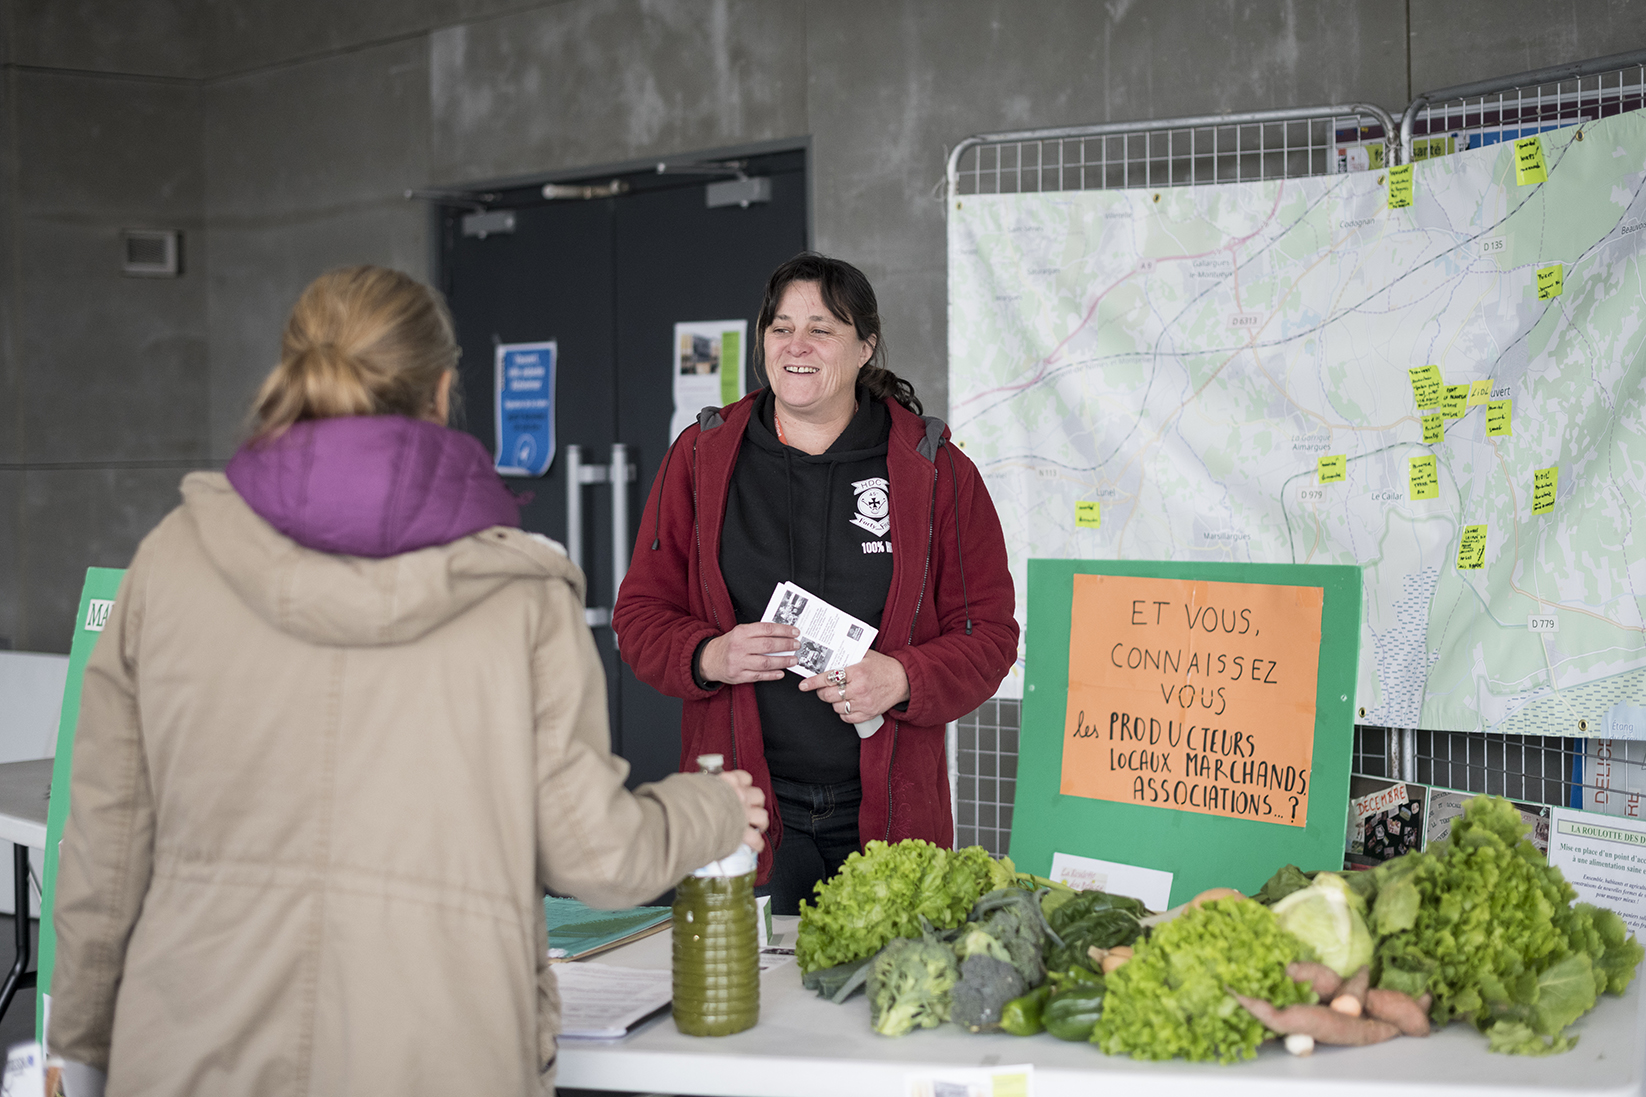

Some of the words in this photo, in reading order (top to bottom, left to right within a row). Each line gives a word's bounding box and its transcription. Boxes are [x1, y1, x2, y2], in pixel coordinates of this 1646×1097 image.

[1340, 218, 1376, 229] Codognan
[1491, 239, 1503, 250] 135
[1240, 316, 1257, 325] 6313
[1490, 387, 1511, 398] uvert
[1292, 443, 1331, 453] Aimargues
[1045, 469, 1057, 477] 113
[1096, 487, 1116, 497] Lunel
[1301, 490, 1307, 499] D
[1308, 490, 1323, 499] 979
[1371, 492, 1380, 500] Le
[1381, 491, 1403, 500] Cailar
[861, 541, 885, 554] 100%
[87, 603, 110, 627] MA
[1131, 600, 1171, 625] ET
[1184, 603, 1260, 637] VOUS,
[1531, 619, 1539, 629] D
[1540, 619, 1555, 629] 779
[1111, 643, 1278, 684] CONNAISSEZ
[1160, 683, 1226, 716] VOUS
[1611, 720, 1634, 733] Étang
[1072, 710, 1099, 739] les
[1109, 711, 1255, 759] PRODUCTEURS
[1110, 748, 1172, 773] LOCAUX
[1357, 785, 1406, 816] DÉCEMBRE
[1571, 825, 1581, 834] LA
[1582, 827, 1623, 841] ROULOTTE
[1624, 833, 1639, 843] DES
[1560, 842, 1574, 852] Mise
[1582, 847, 1598, 857] place
[1599, 849, 1612, 858] d'un
[1614, 853, 1630, 861] point
[1589, 858, 1625, 871] alimentation
[1626, 864, 1642, 874] saine
[1582, 874, 1604, 883] Ensemble,
[1605, 878, 1623, 887] habitants
[1603, 886, 1622, 894] nouvelles
[1606, 894, 1622, 902] manger
